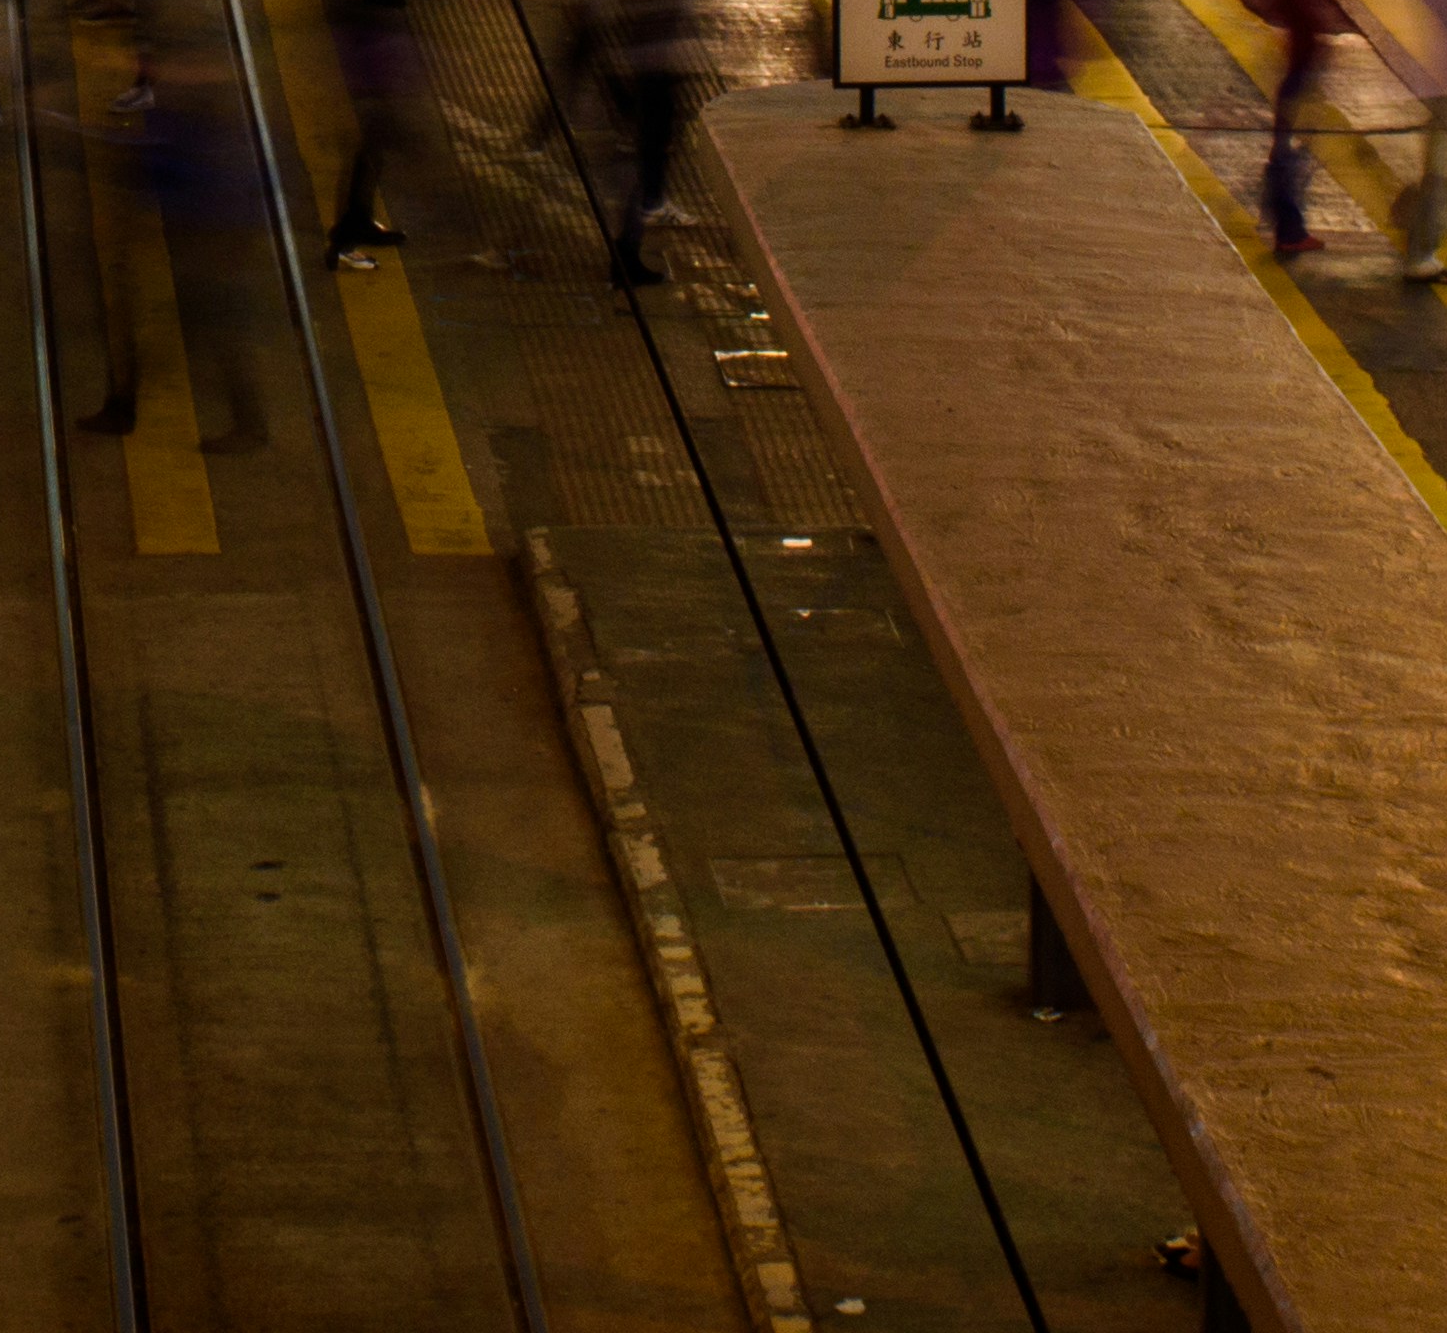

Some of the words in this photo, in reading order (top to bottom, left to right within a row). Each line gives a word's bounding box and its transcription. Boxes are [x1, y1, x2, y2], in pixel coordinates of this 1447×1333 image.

[886, 29, 983, 51] 東行站
[884, 55, 951, 69] Eastbound
[953, 54, 983, 70] Stop
